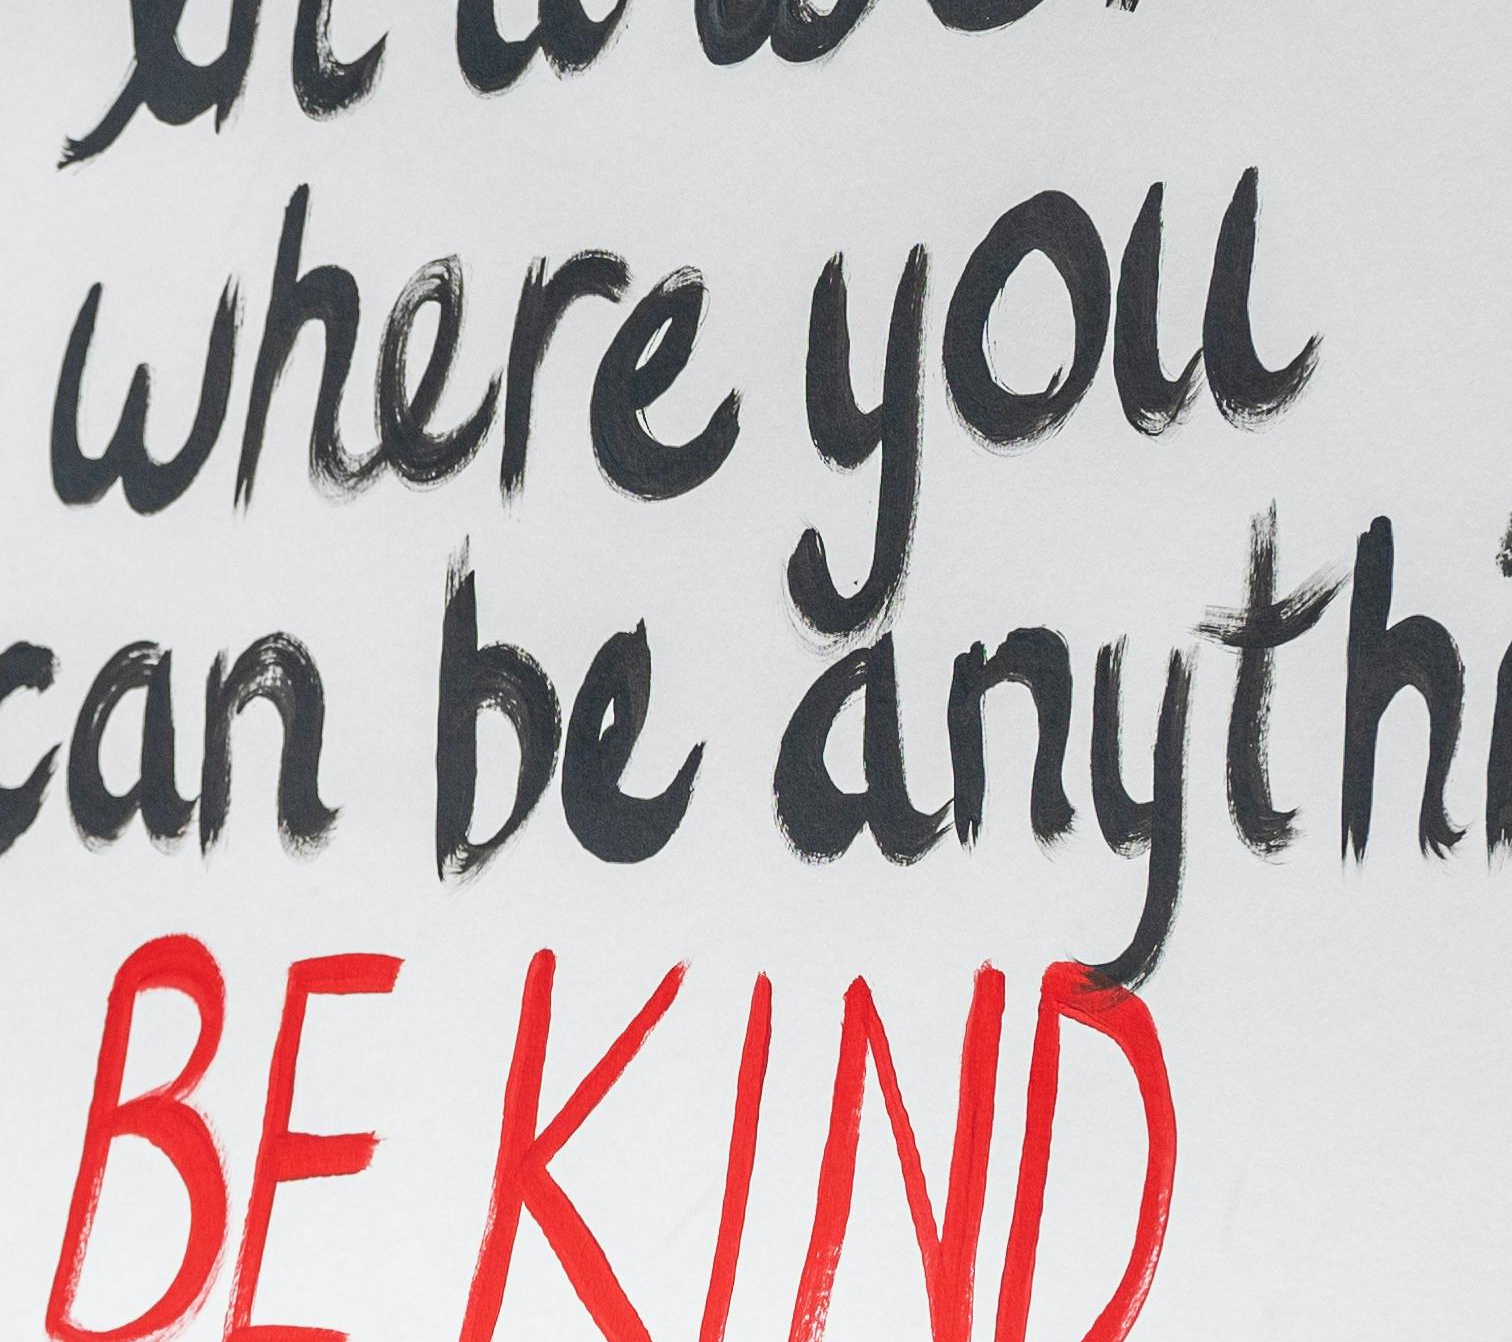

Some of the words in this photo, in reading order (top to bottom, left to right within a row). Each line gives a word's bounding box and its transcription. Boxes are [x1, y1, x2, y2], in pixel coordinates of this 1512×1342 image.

[49, 183, 742, 517] where
[784, 166, 1321, 643] you
[433, 536, 707, 887] be
